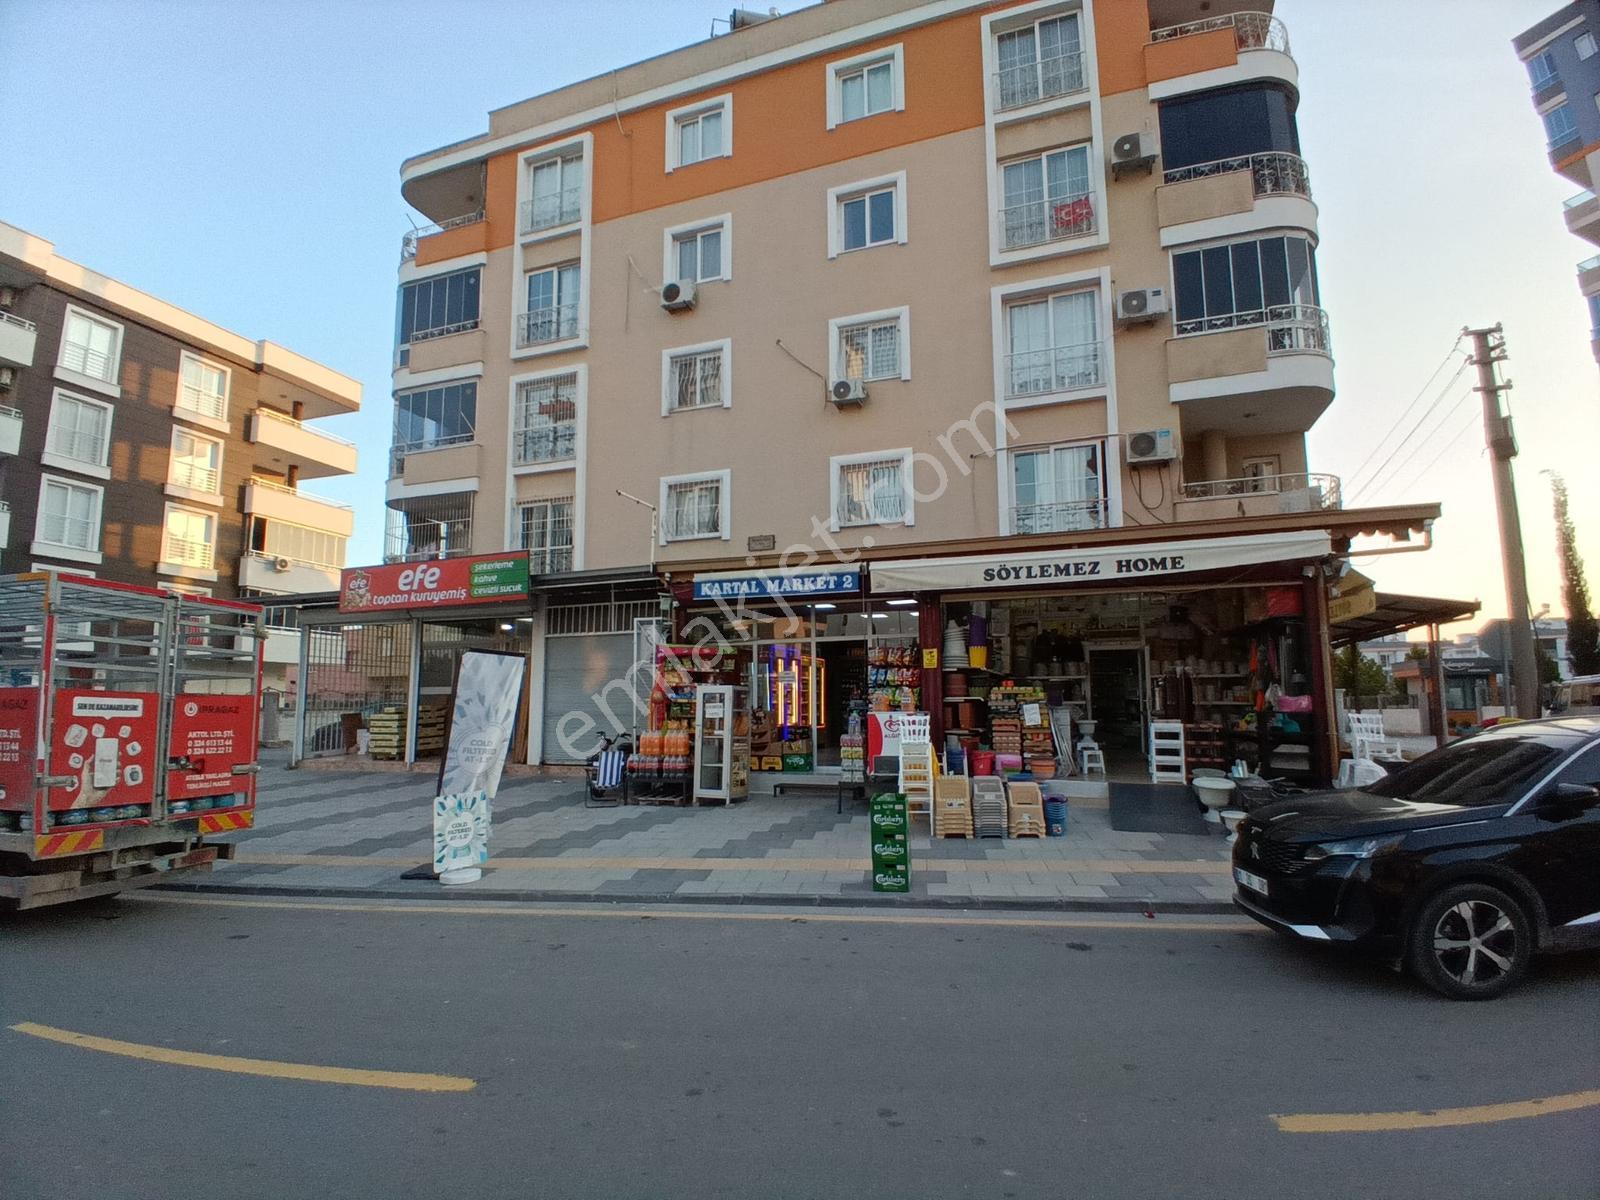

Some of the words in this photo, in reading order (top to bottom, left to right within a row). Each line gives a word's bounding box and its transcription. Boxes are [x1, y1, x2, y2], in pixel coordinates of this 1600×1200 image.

[983, 561, 1101, 582] SÖYLEMEZ
[1116, 556, 1185, 574] HOME
[349, 579, 368, 589] efe
[398, 564, 441, 592] efe
[499, 583, 523, 593] sucuk
[701, 581, 759, 596] KARTAL
[766, 575, 838, 593] MARKET
[842, 575, 853, 589] 2
[373, 594, 408, 606] toptan
[410, 588, 467, 604] kuruyemiş
[873, 814, 904, 826] Carlsberg
[874, 843, 905, 856] Carlsberg
[875, 874, 906, 886] Carlsberg
